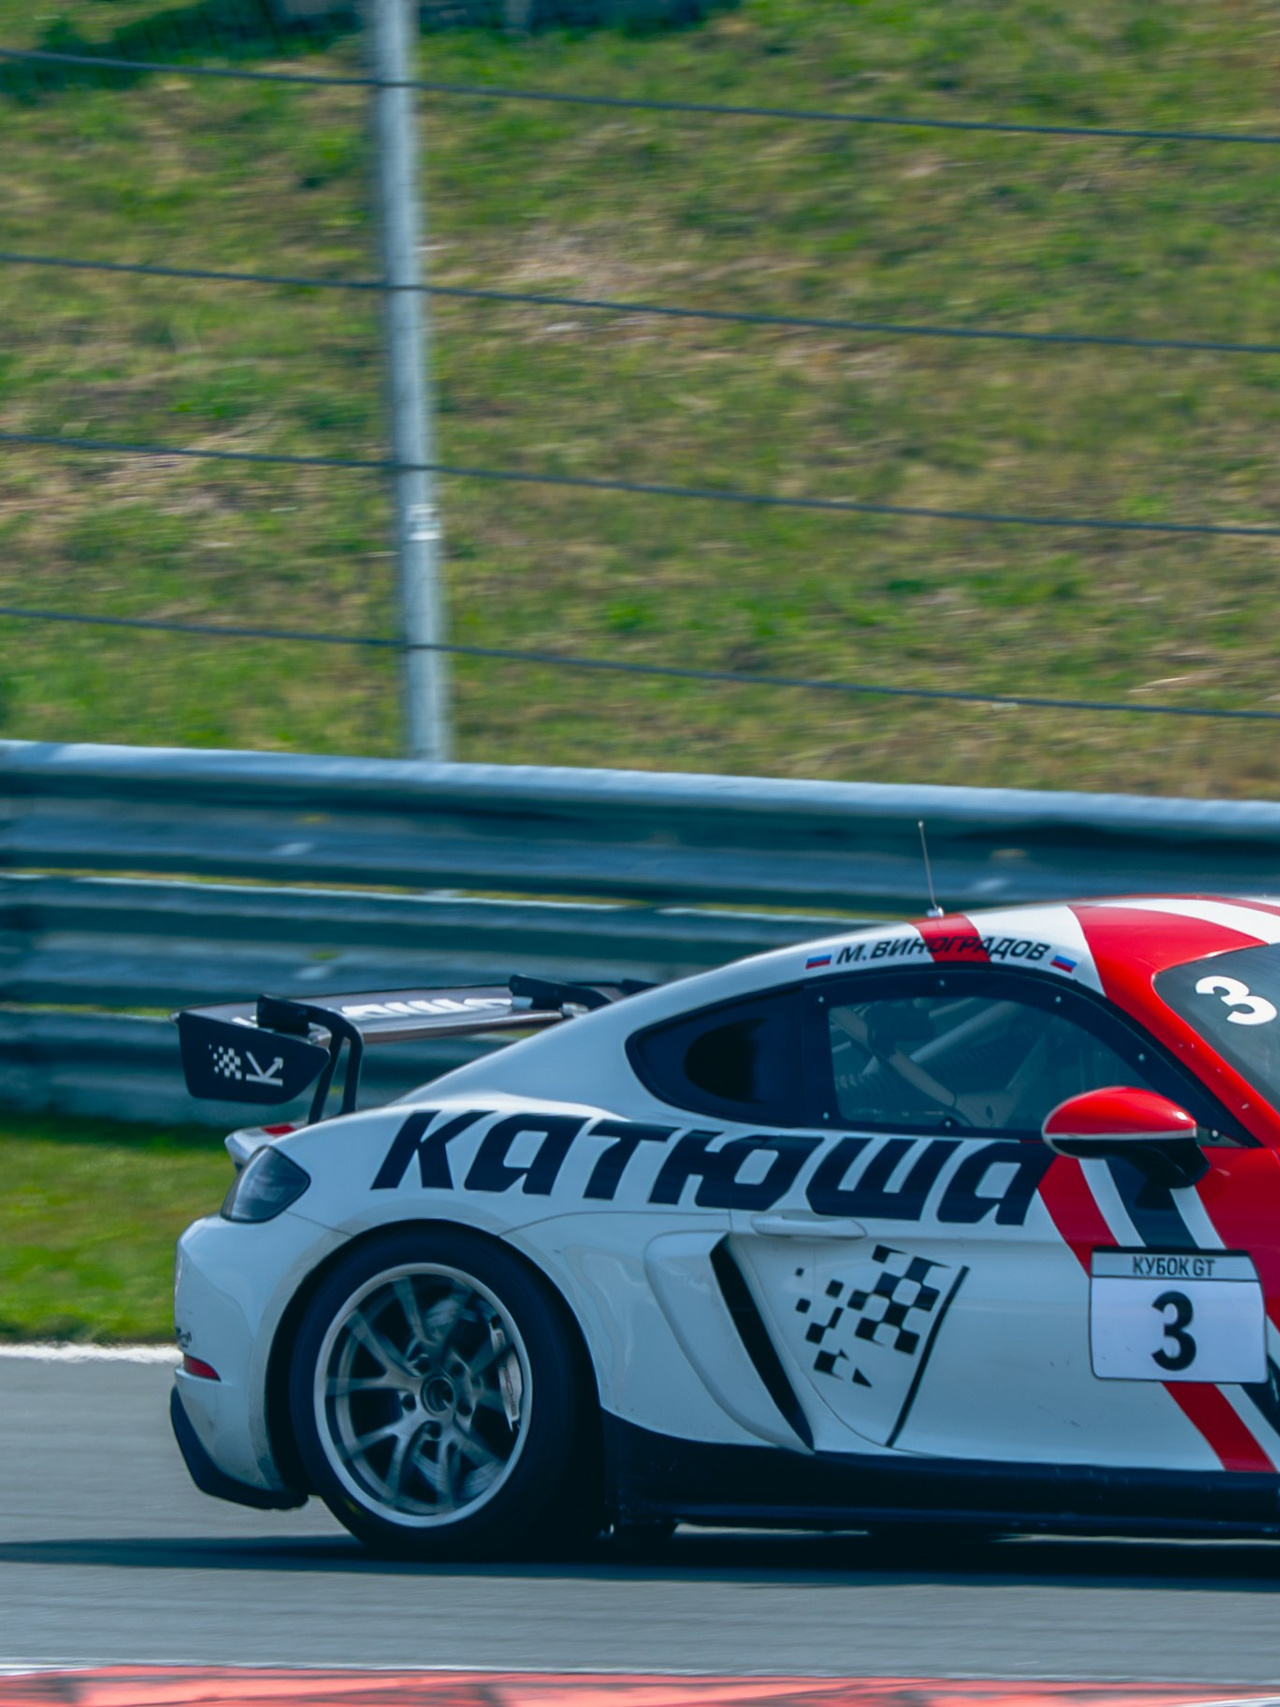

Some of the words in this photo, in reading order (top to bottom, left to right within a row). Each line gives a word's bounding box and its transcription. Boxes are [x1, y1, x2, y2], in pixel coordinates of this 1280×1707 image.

[1195, 975, 1278, 1026] 3
[370, 1110, 1056, 1226] КАТЮША
[1133, 1256, 1189, 1276] КУБОК
[1193, 1258, 1215, 1276] GT
[1151, 1290, 1197, 1372] 3
